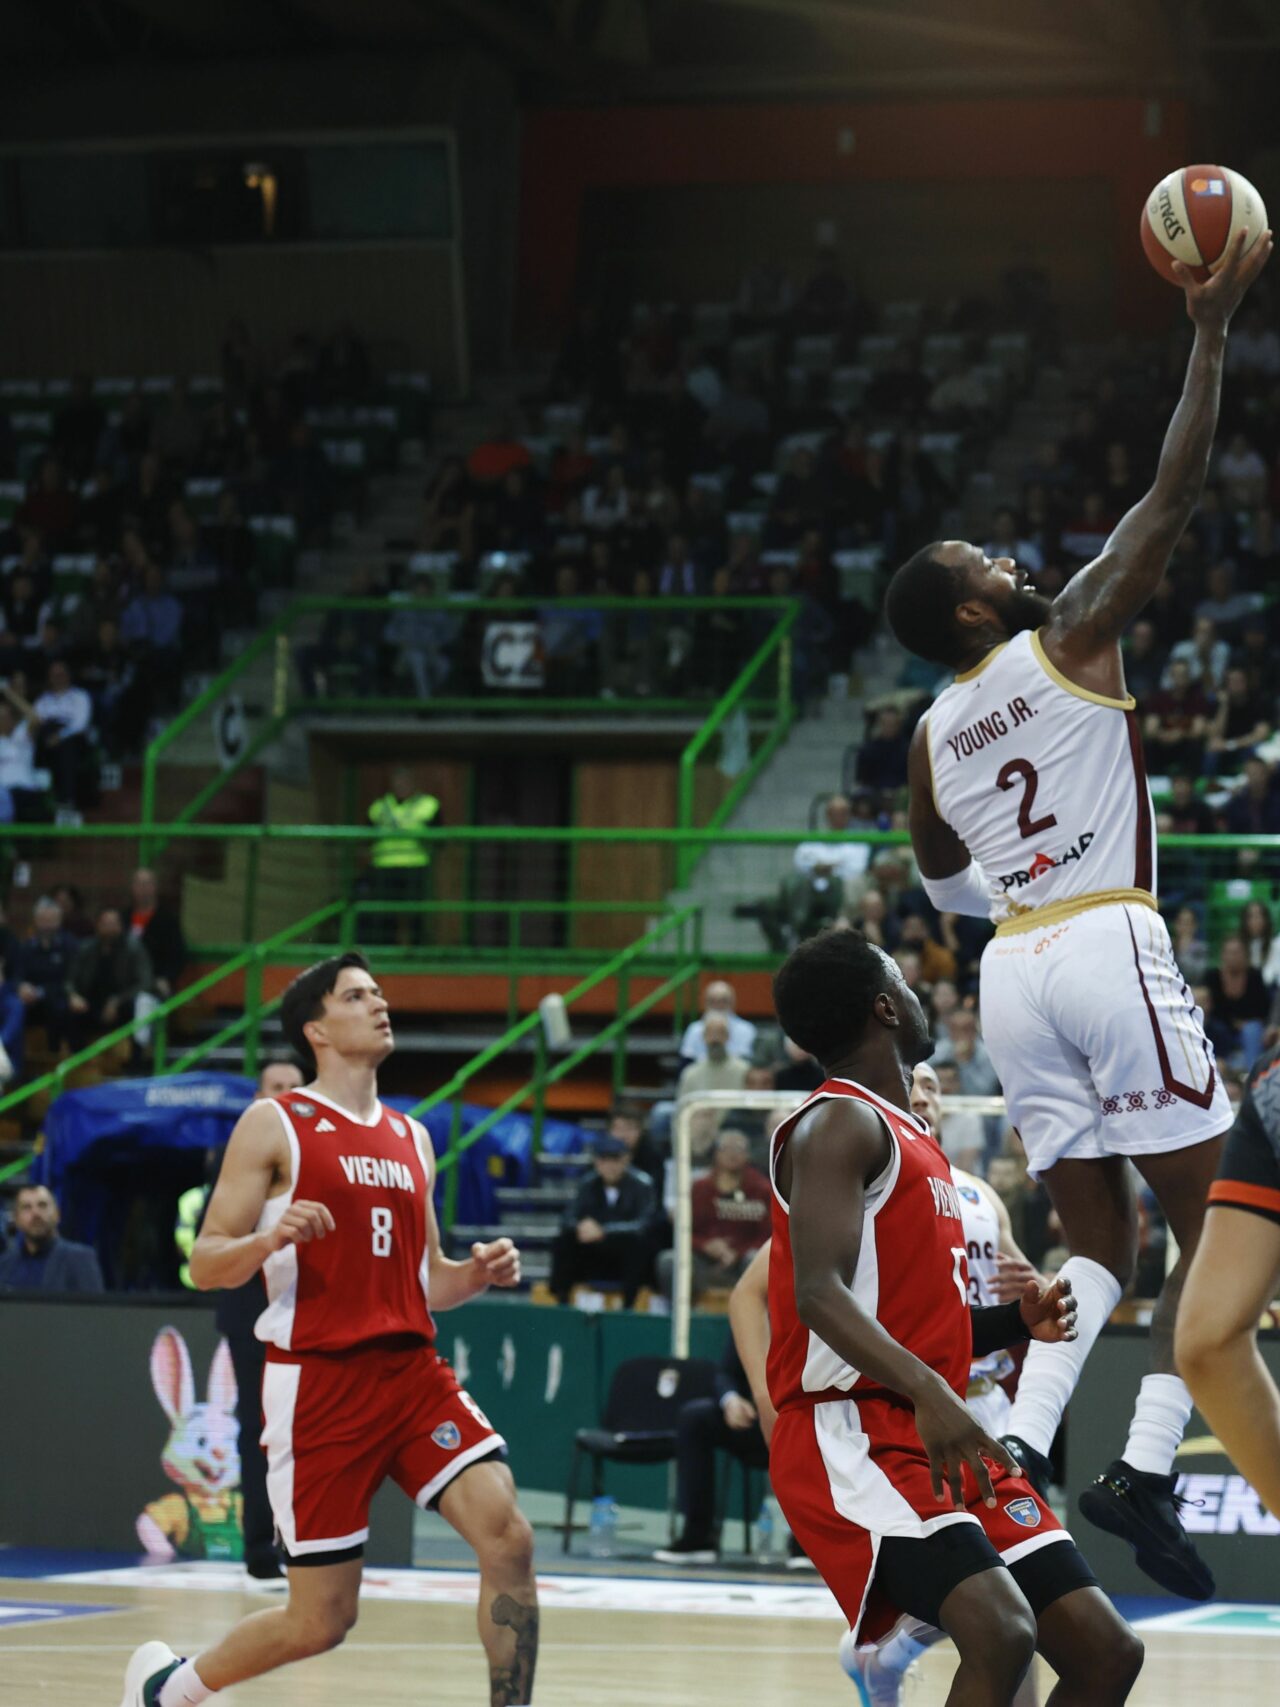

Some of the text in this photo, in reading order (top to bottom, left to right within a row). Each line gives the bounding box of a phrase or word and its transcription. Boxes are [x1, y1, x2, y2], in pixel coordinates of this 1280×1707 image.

[947, 696, 1039, 762] YOUNG JR.
[996, 758, 1058, 839] 2
[338, 1155, 416, 1194] VIENNA
[370, 1206, 393, 1258] 8
